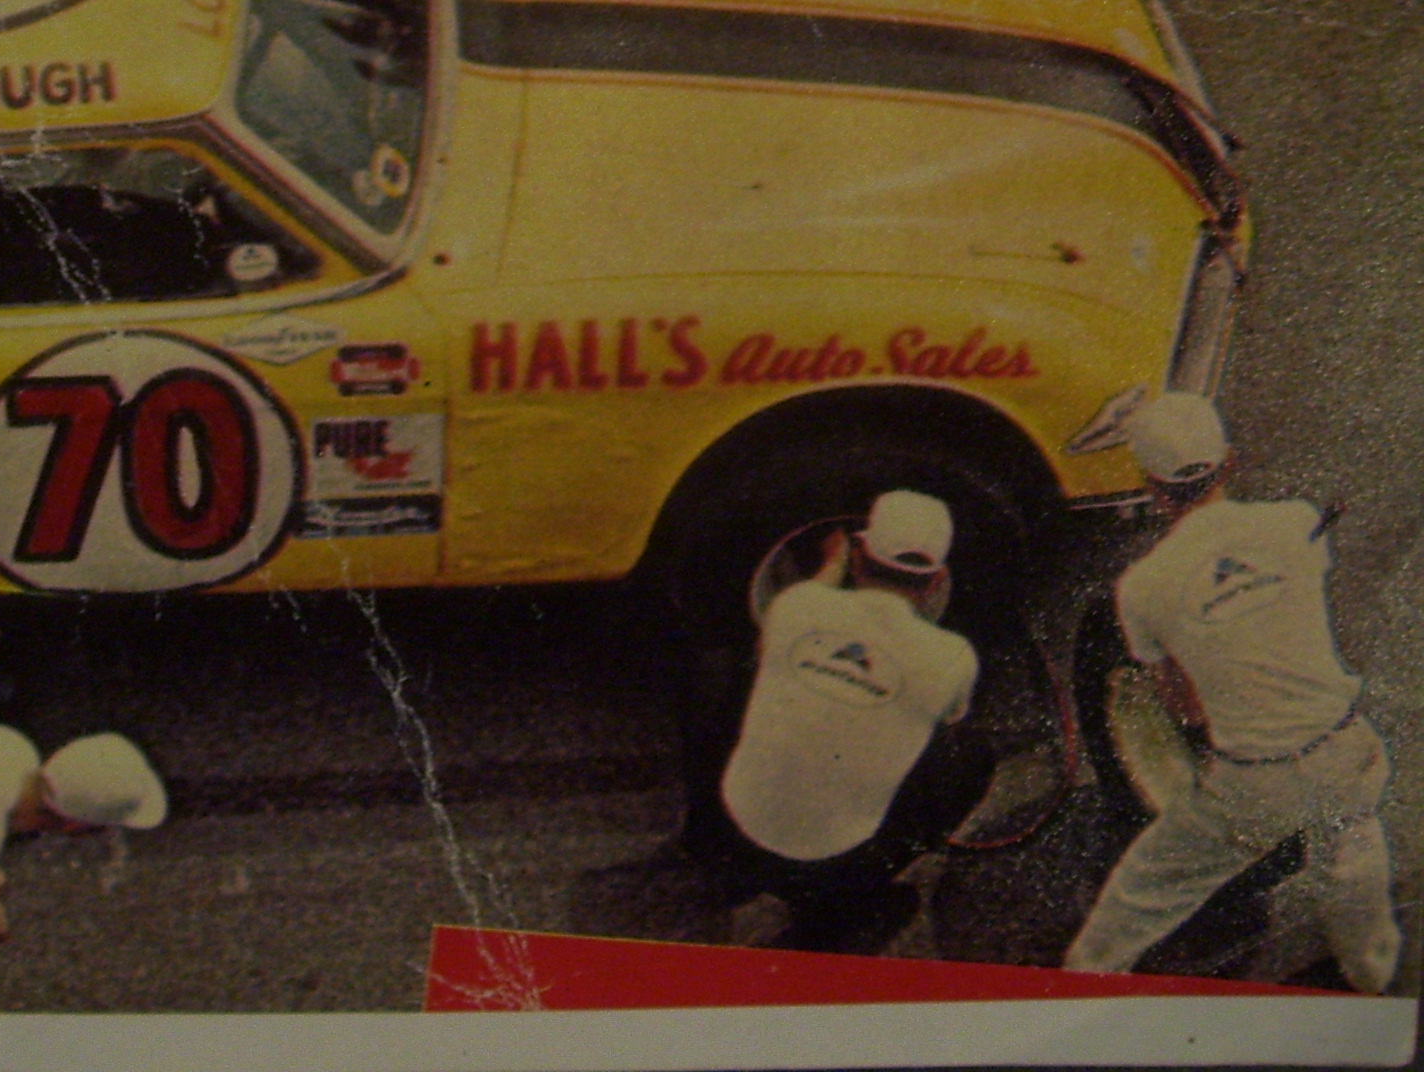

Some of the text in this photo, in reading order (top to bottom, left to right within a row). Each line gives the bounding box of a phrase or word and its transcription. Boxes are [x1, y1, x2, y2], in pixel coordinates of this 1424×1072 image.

[470, 316, 708, 393] HALL'S
[720, 334, 865, 385] Auto
[874, 325, 1039, 379] Sales
[6, 367, 259, 563] 70
[314, 420, 391, 459] PURE
